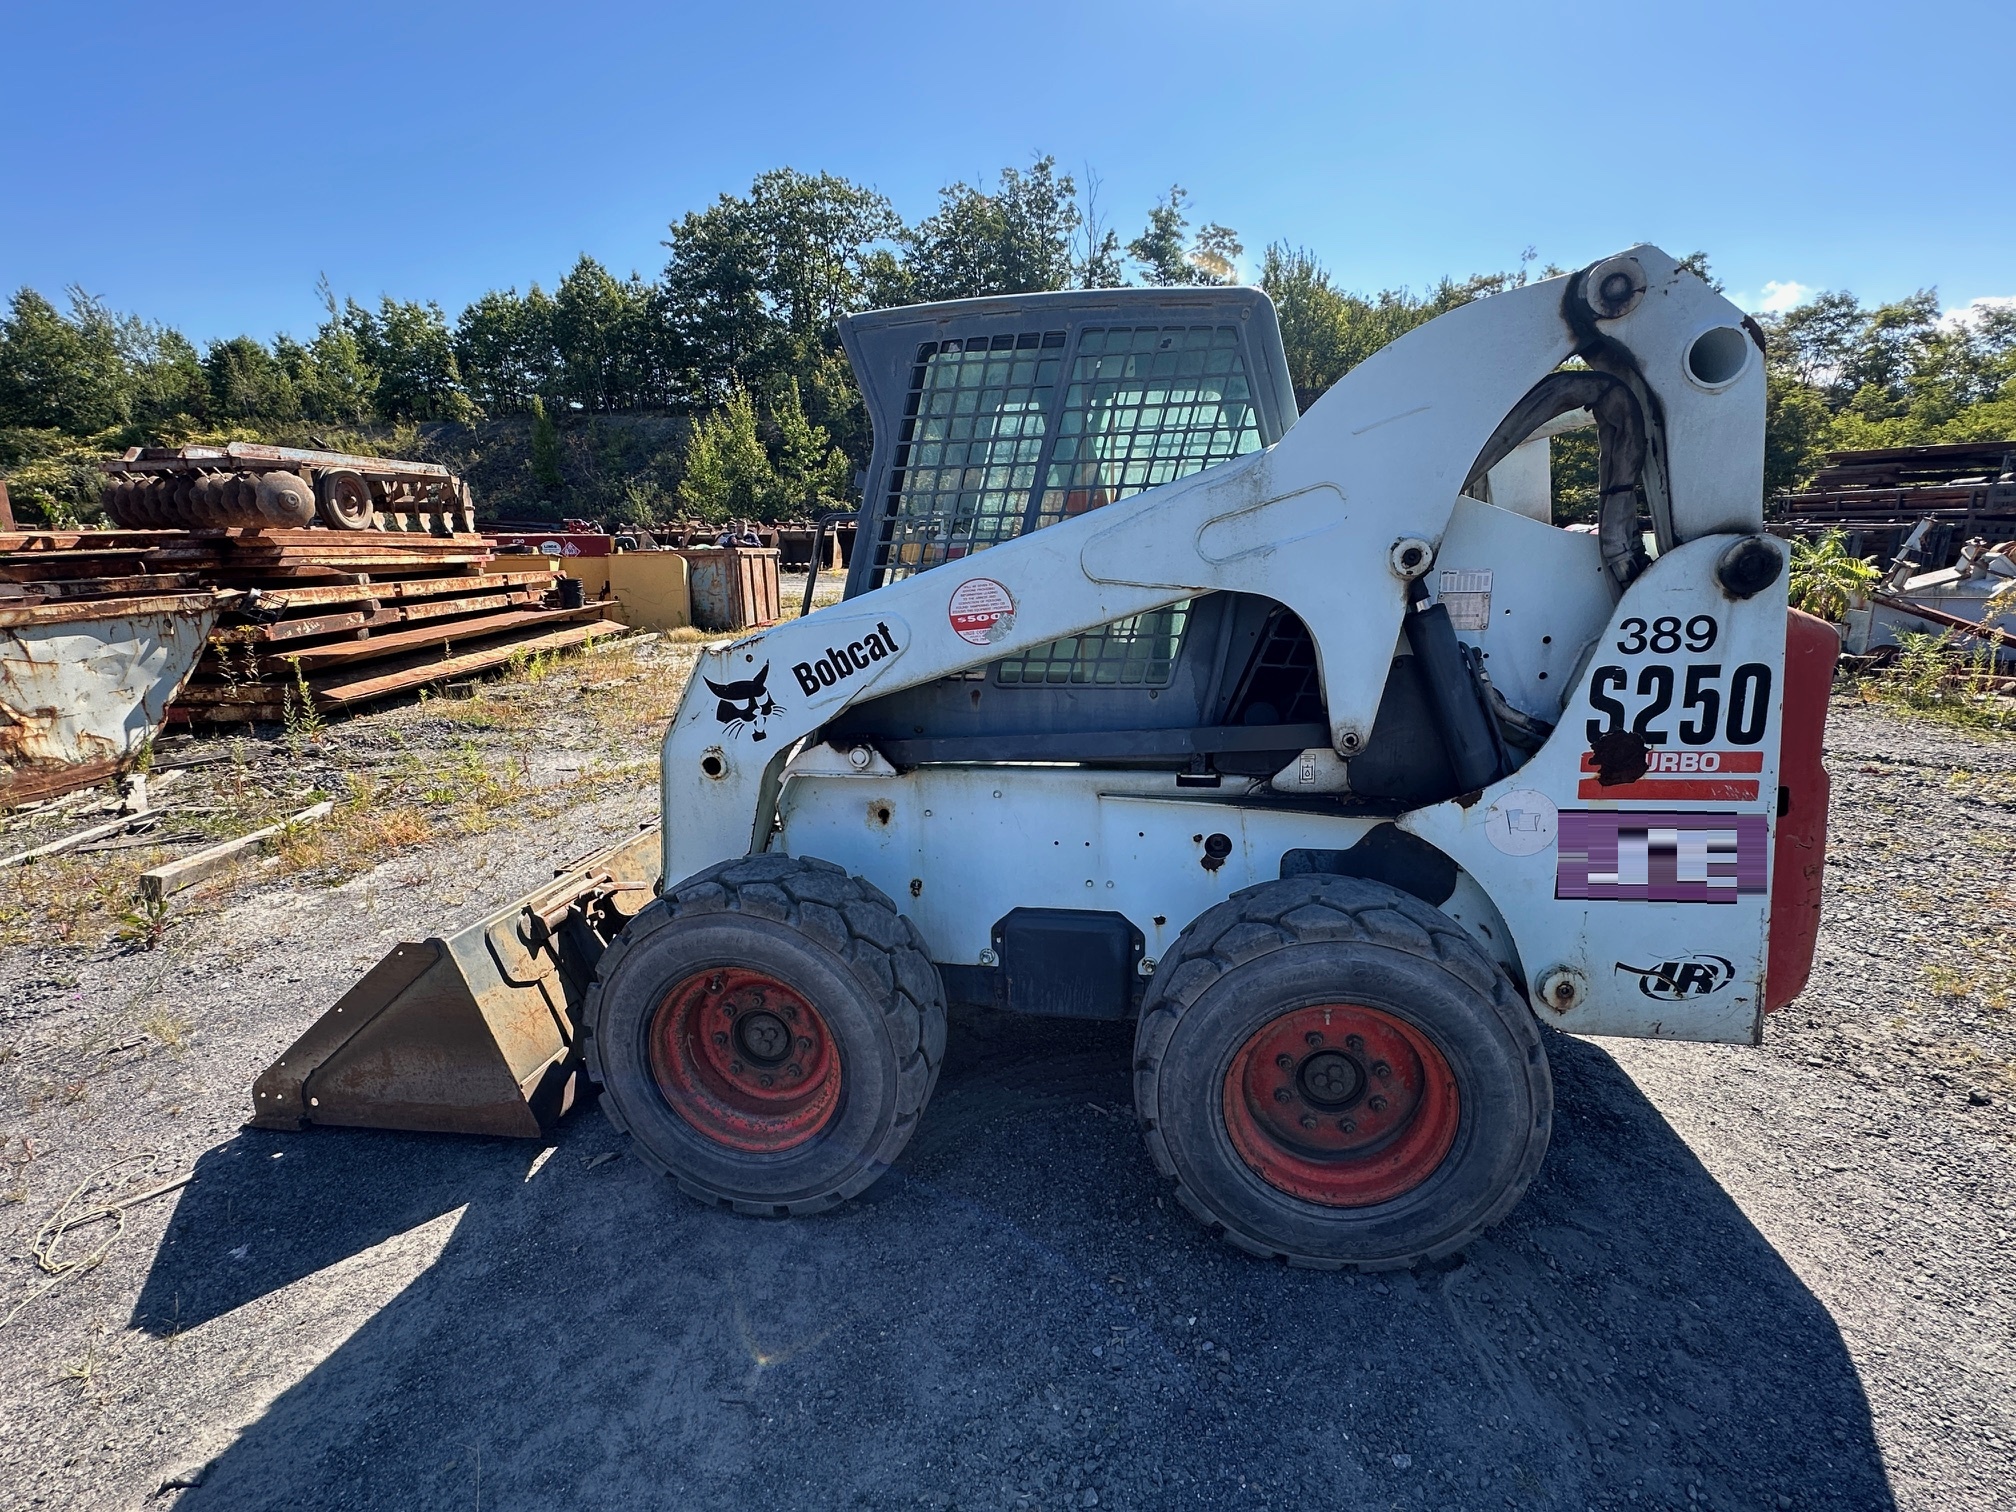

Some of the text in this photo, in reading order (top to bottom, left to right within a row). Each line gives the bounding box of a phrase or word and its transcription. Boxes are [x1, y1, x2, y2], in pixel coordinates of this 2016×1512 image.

[957, 613, 1001, 623] $500
[1617, 614, 1718, 655] 389
[791, 621, 899, 697] Bobcat
[1586, 662, 1772, 745] S250
[1645, 752, 1720, 772] URBO
